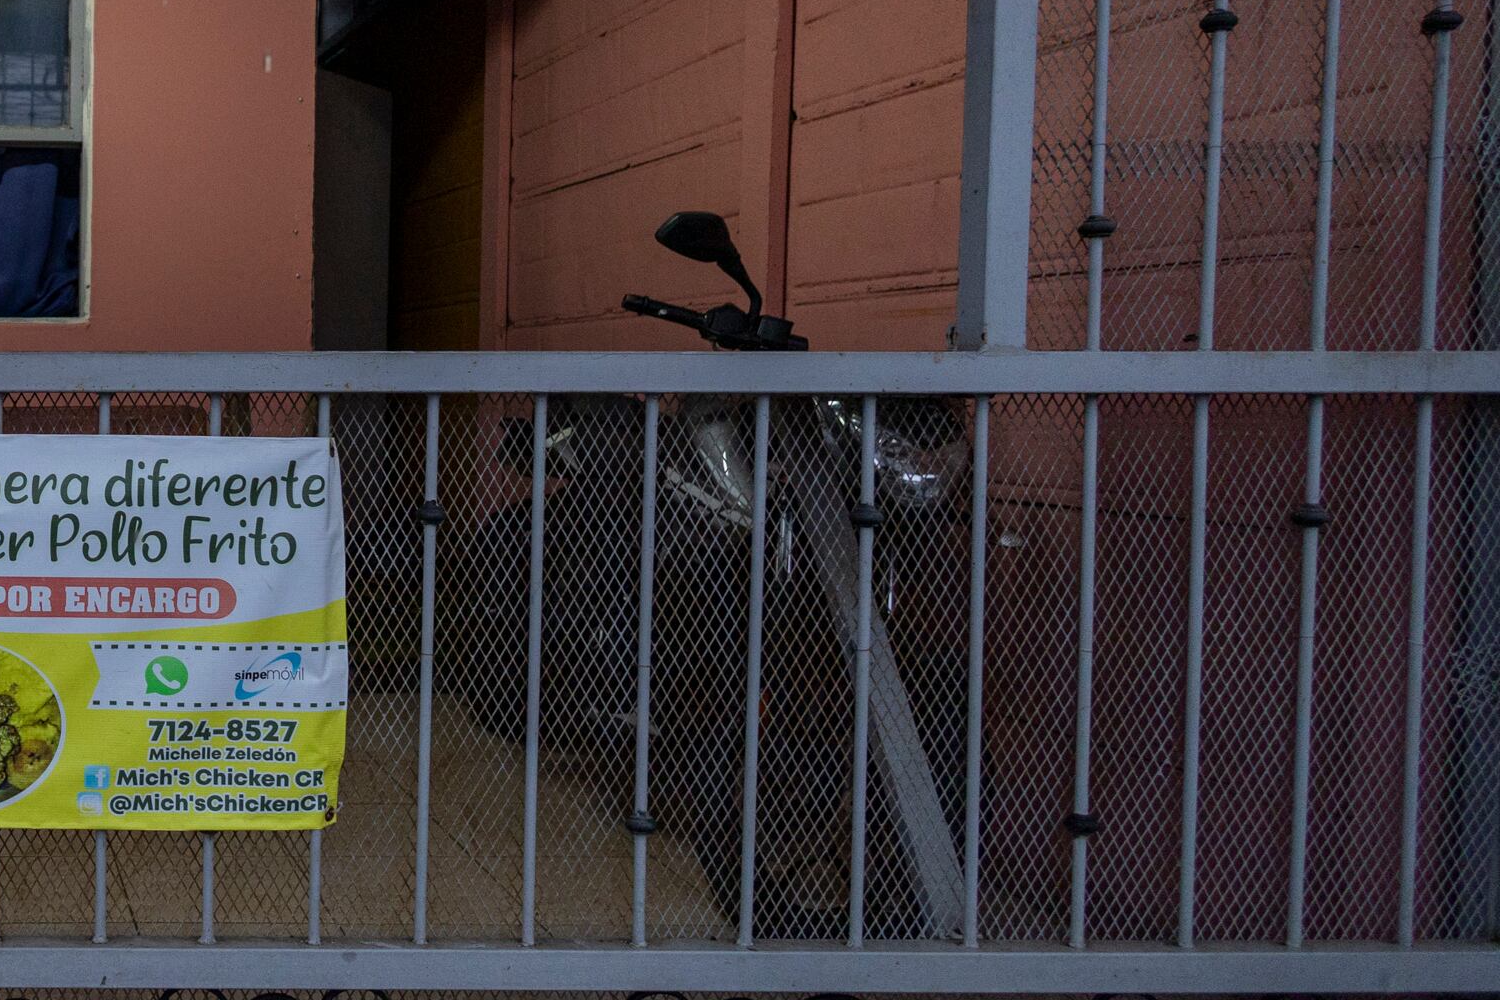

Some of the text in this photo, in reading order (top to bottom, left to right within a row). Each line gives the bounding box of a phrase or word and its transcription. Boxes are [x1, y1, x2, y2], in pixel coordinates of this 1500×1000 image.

[104, 458, 326, 509] diferente
[50, 510, 168, 564] Pollo
[183, 515, 298, 567] Frito
[65, 584, 220, 614] ENCARGO
[149, 720, 297, 743] 7124-8527
[150, 748, 296, 762] Michelle Zeledón
[117, 769, 324, 787] Mich's Chicken CR
[109, 794, 328, 814] @Mich'sChickenCR
